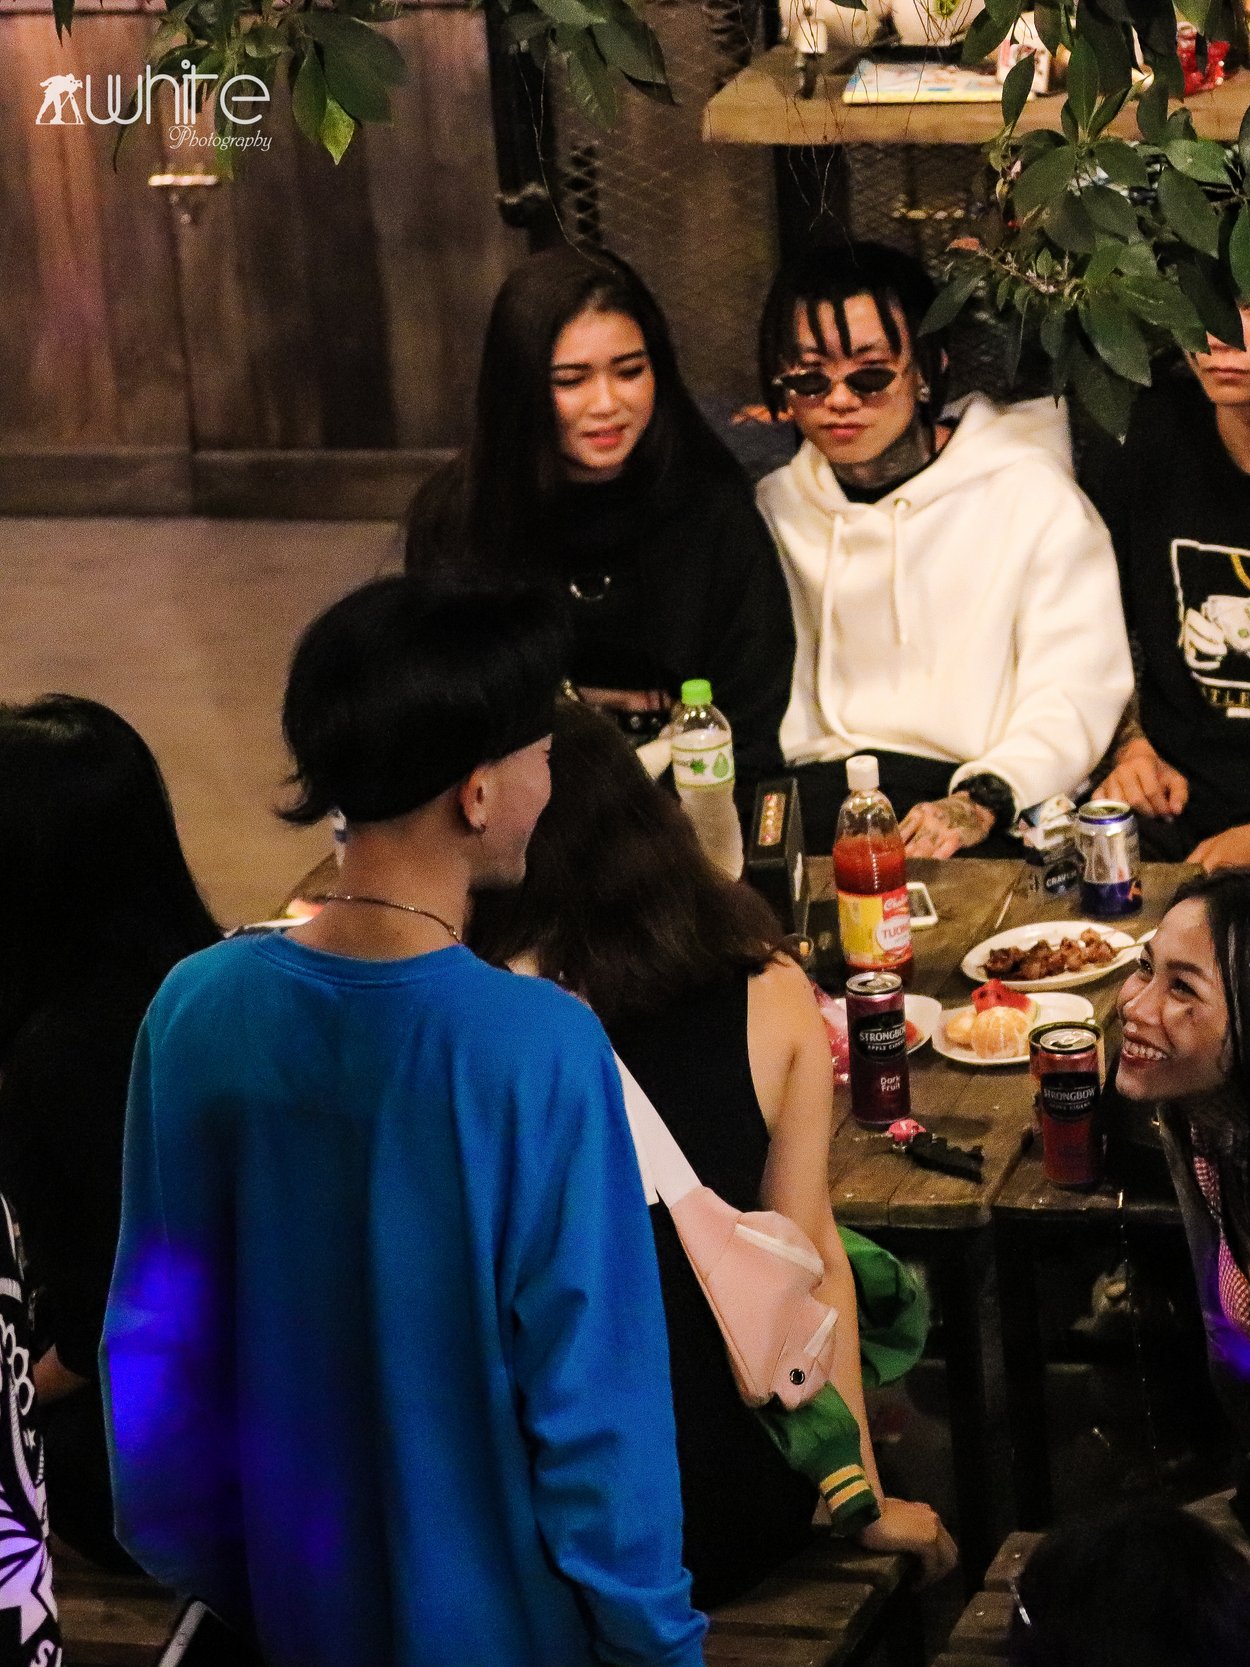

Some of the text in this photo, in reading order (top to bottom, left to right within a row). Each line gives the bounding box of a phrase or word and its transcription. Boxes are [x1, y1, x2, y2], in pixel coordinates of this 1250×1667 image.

[860, 1025, 905, 1042] STRONGBO
[881, 1075, 900, 1085] Dark
[881, 1083, 900, 1092] Fruit
